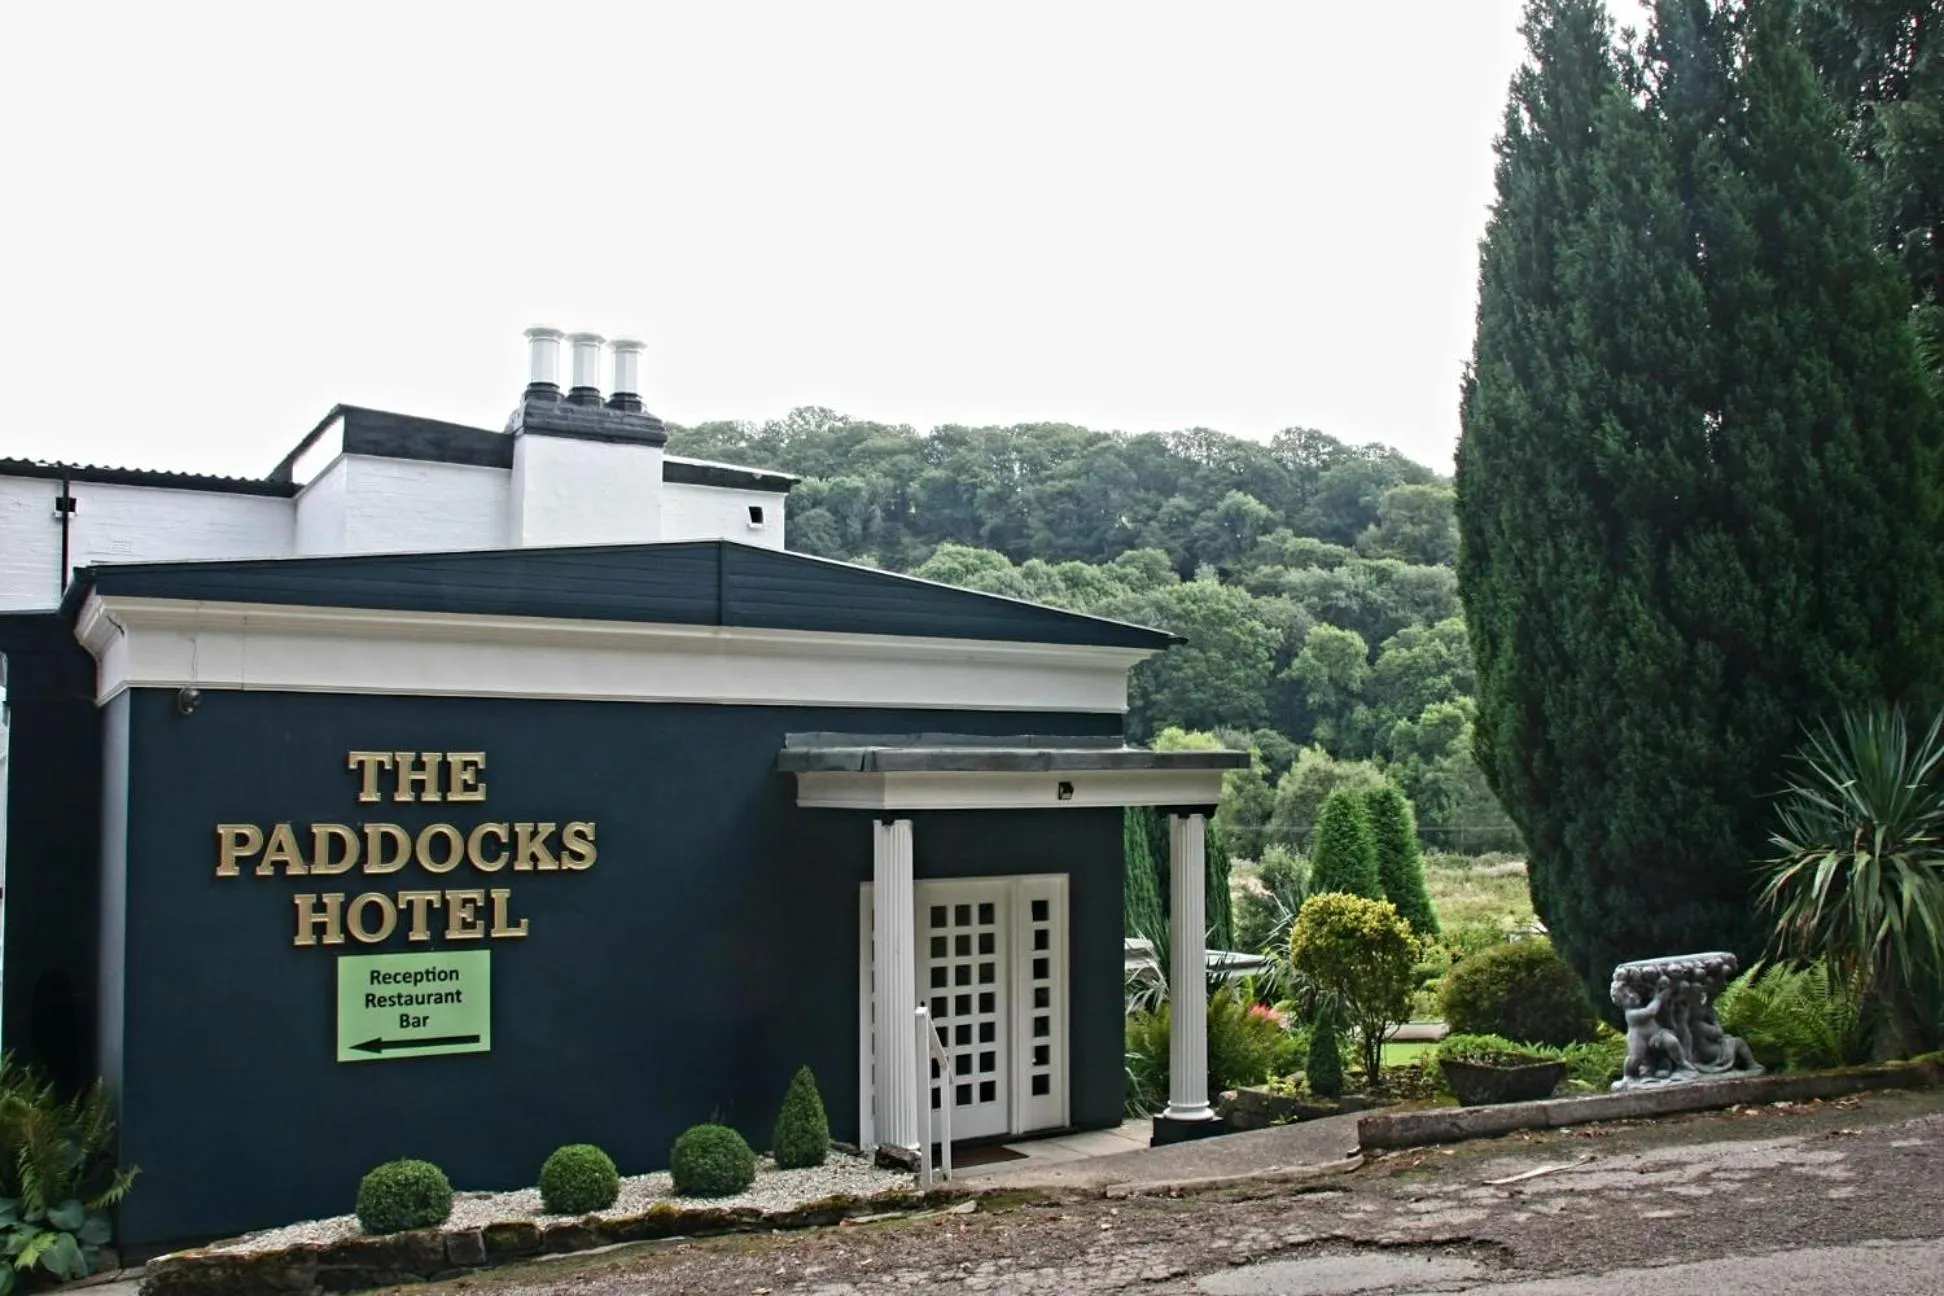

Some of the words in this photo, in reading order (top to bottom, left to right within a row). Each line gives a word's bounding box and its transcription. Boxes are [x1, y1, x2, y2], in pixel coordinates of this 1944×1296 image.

[348, 751, 487, 802] THE
[215, 821, 598, 877] PADDOCKS
[293, 888, 530, 946] HOTEL
[369, 966, 460, 987] Reception
[364, 988, 463, 1009] Restaurant
[398, 1012, 430, 1029] Bar
